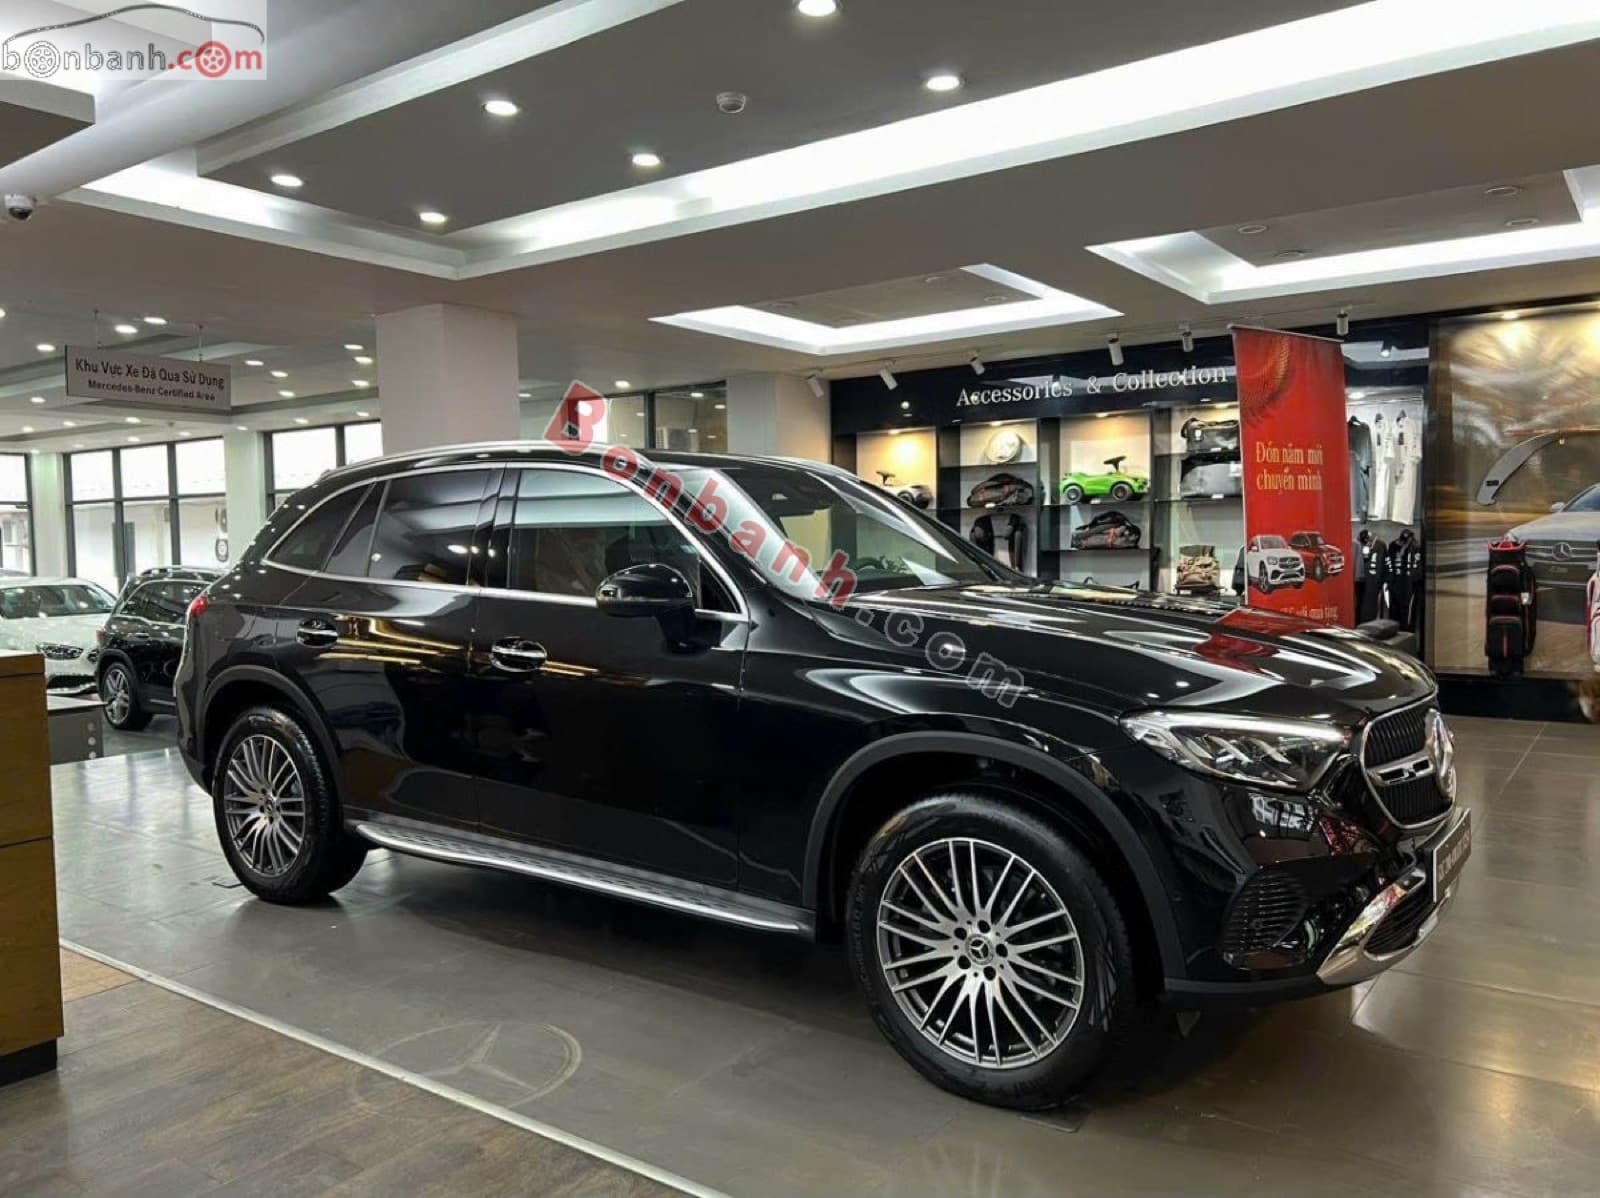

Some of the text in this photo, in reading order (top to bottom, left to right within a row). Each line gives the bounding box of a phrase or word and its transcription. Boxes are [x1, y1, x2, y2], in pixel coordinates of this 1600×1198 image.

[75, 358, 98, 373] Khu
[126, 364, 139, 377] Xe
[159, 368, 180, 382] Qua
[956, 365, 1227, 406] Accessories & Collection
